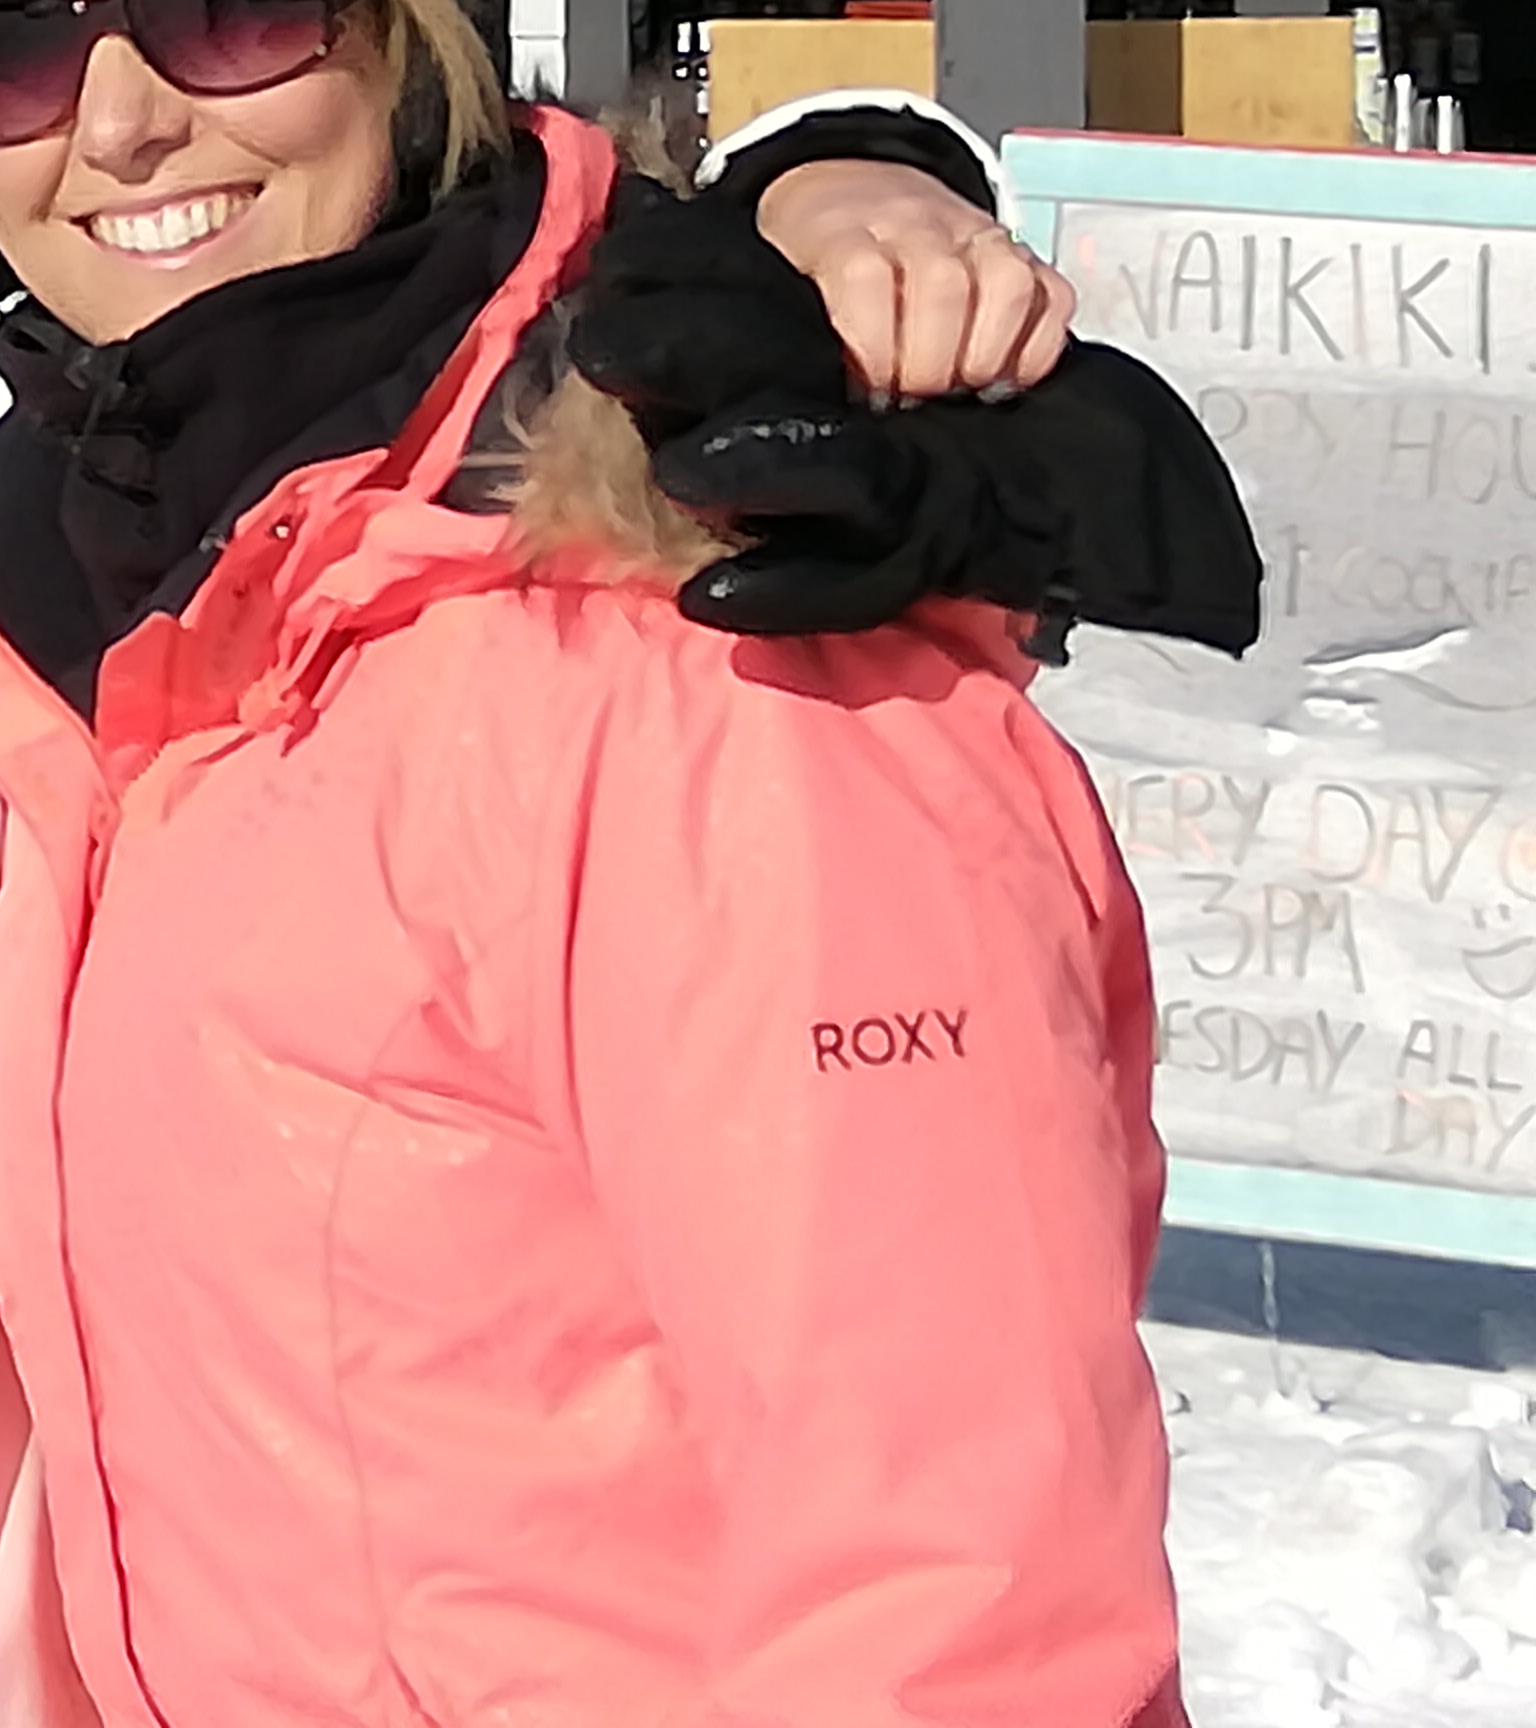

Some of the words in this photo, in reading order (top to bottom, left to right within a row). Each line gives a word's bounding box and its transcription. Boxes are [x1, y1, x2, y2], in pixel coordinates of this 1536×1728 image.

[1306, 782, 1504, 904] DAY
[1178, 870, 1366, 995] 3PM
[810, 1008, 968, 1074] ROXY
[1395, 1018, 1524, 1094] ALL
[1384, 1090, 1536, 1172] DAY
